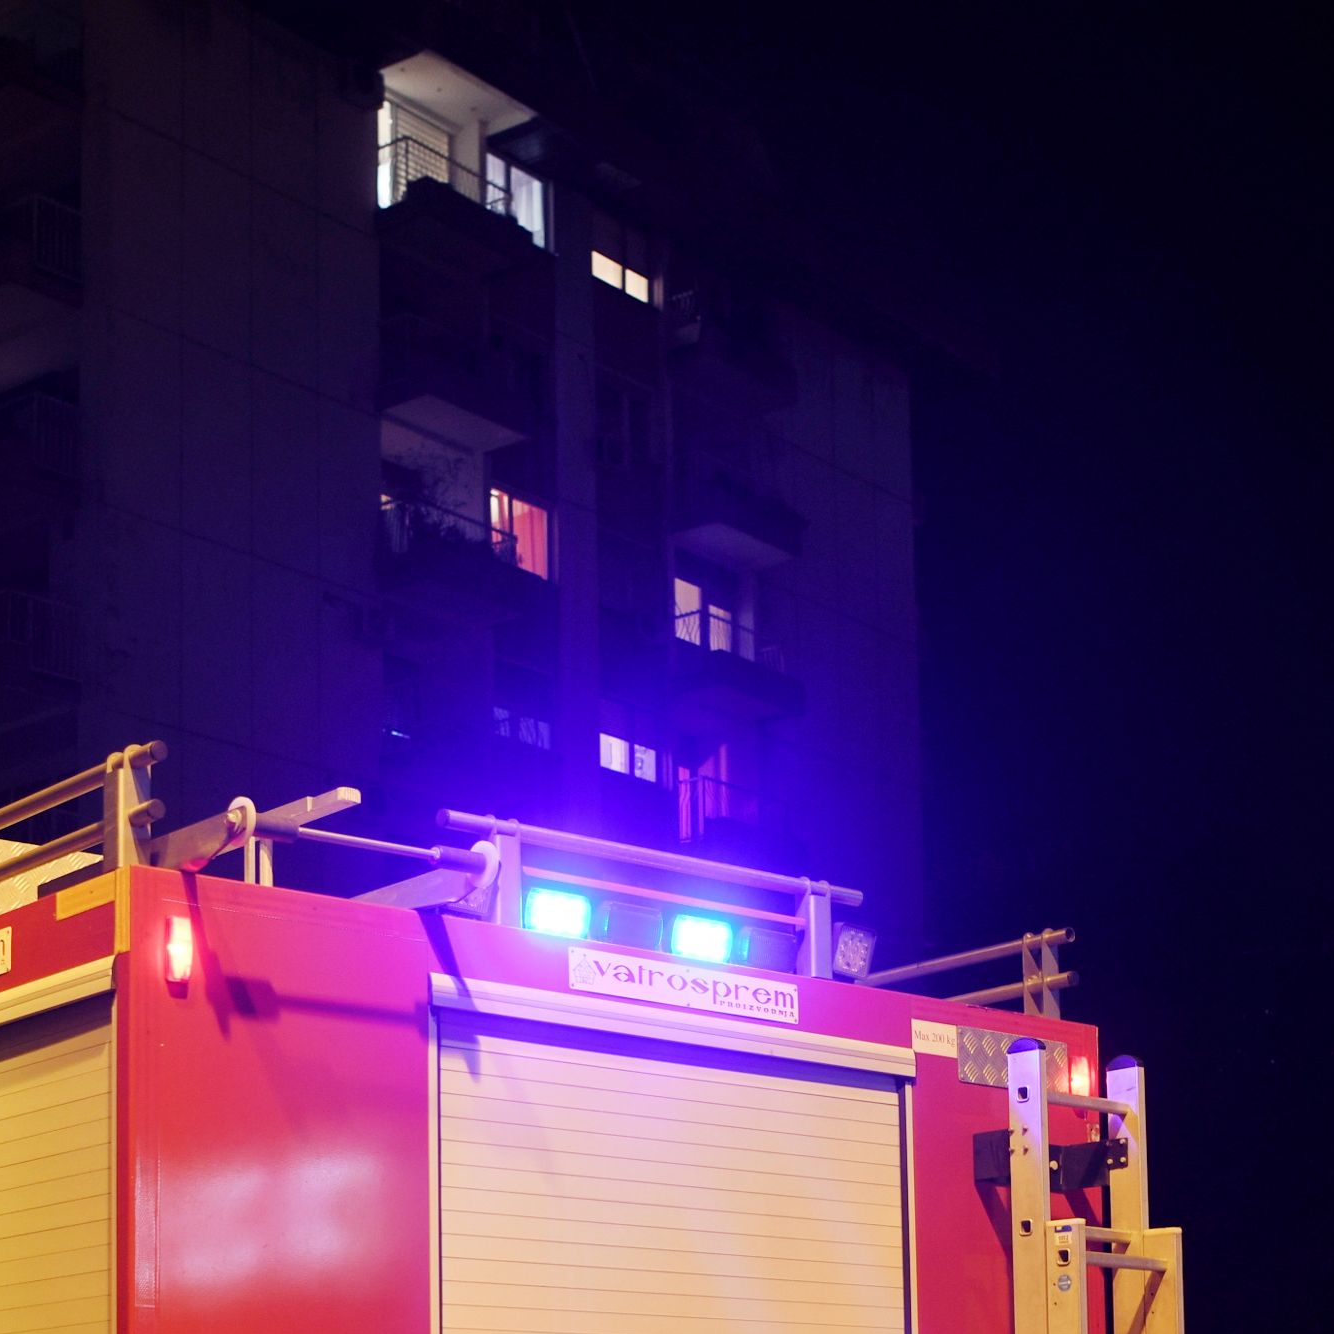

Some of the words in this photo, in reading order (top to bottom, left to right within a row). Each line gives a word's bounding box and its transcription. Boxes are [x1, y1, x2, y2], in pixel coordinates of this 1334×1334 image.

[593, 959, 796, 1010] vatrosprem
[719, 1000, 795, 1018] PROIZVODNJA
[914, 1029, 930, 1041] Max
[931, 1032, 945, 1043] 200
